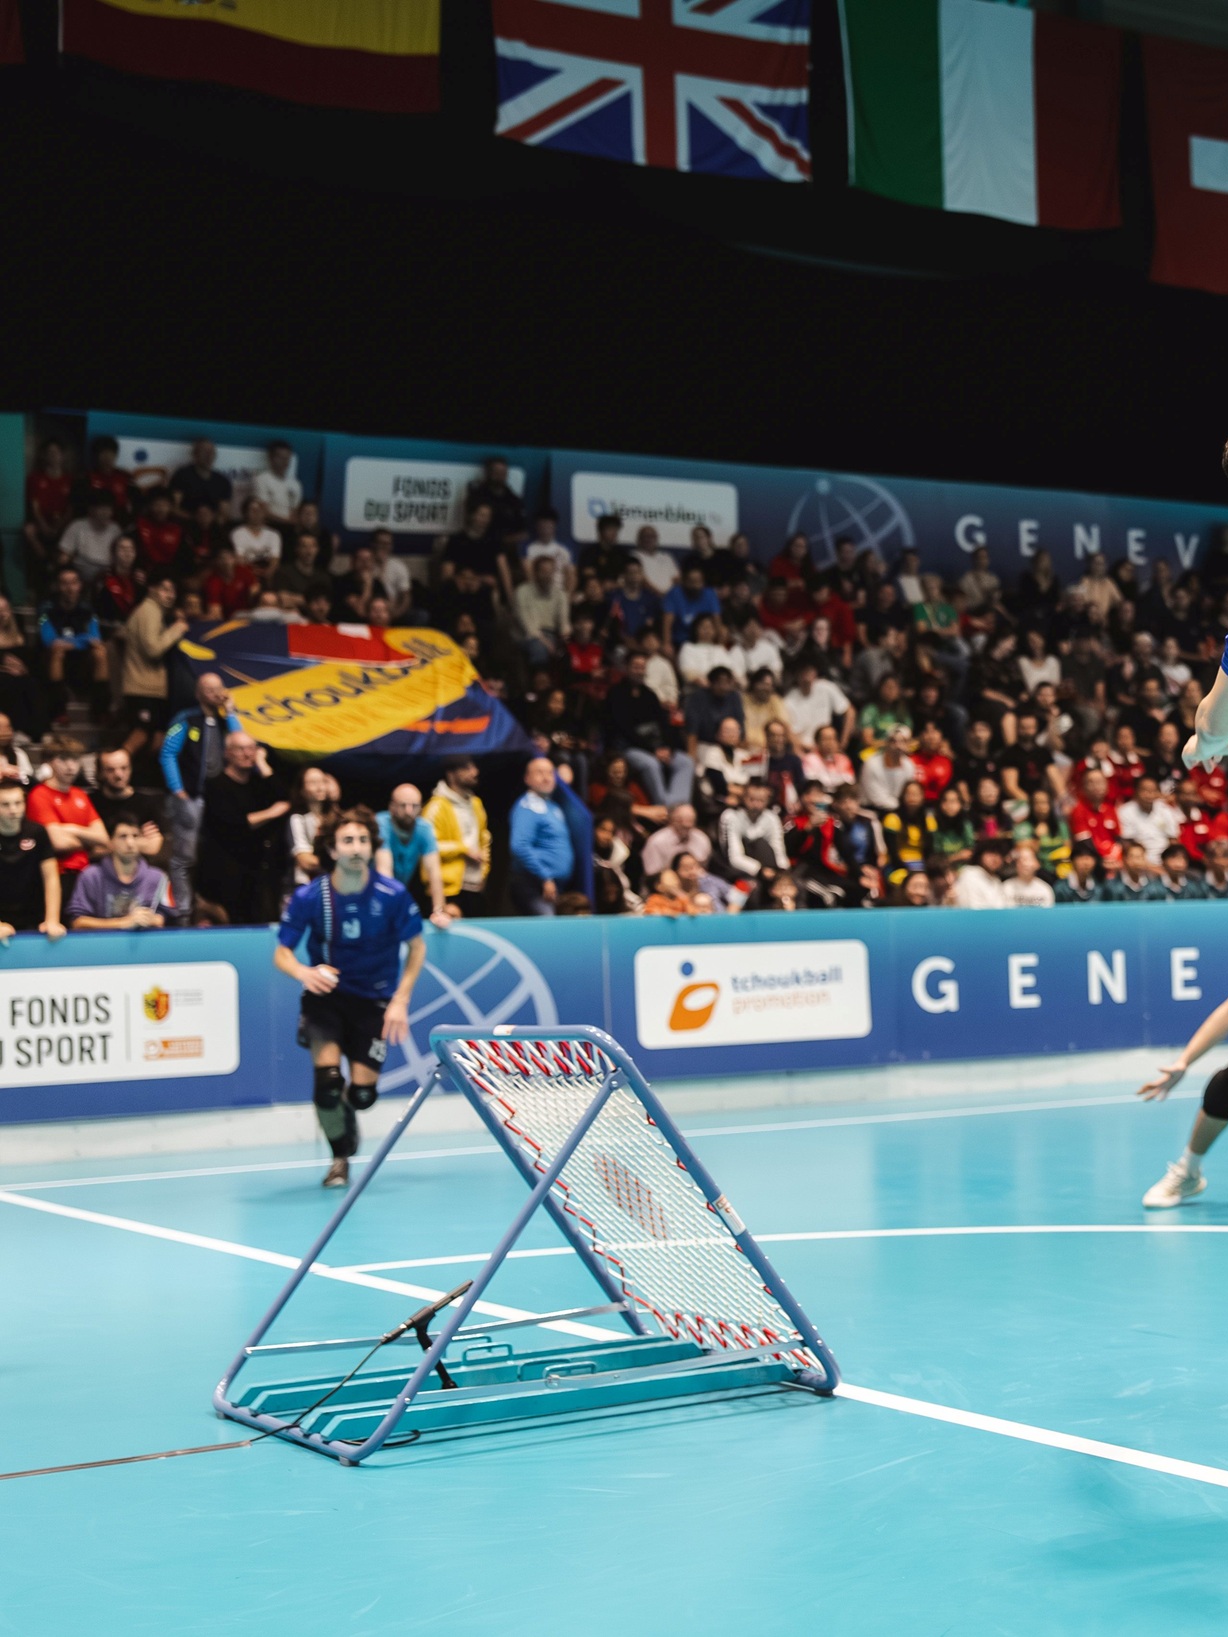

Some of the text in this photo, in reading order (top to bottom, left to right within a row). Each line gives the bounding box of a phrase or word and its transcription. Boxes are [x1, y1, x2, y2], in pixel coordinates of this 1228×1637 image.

[393, 476, 451, 499] FONDS
[364, 499, 449, 524] DU SPORT
[730, 964, 844, 993] tchoukball
[9, 993, 112, 1028] FONDS
[732, 989, 833, 1015] promotion
[15, 1031, 113, 1068] SPORT
